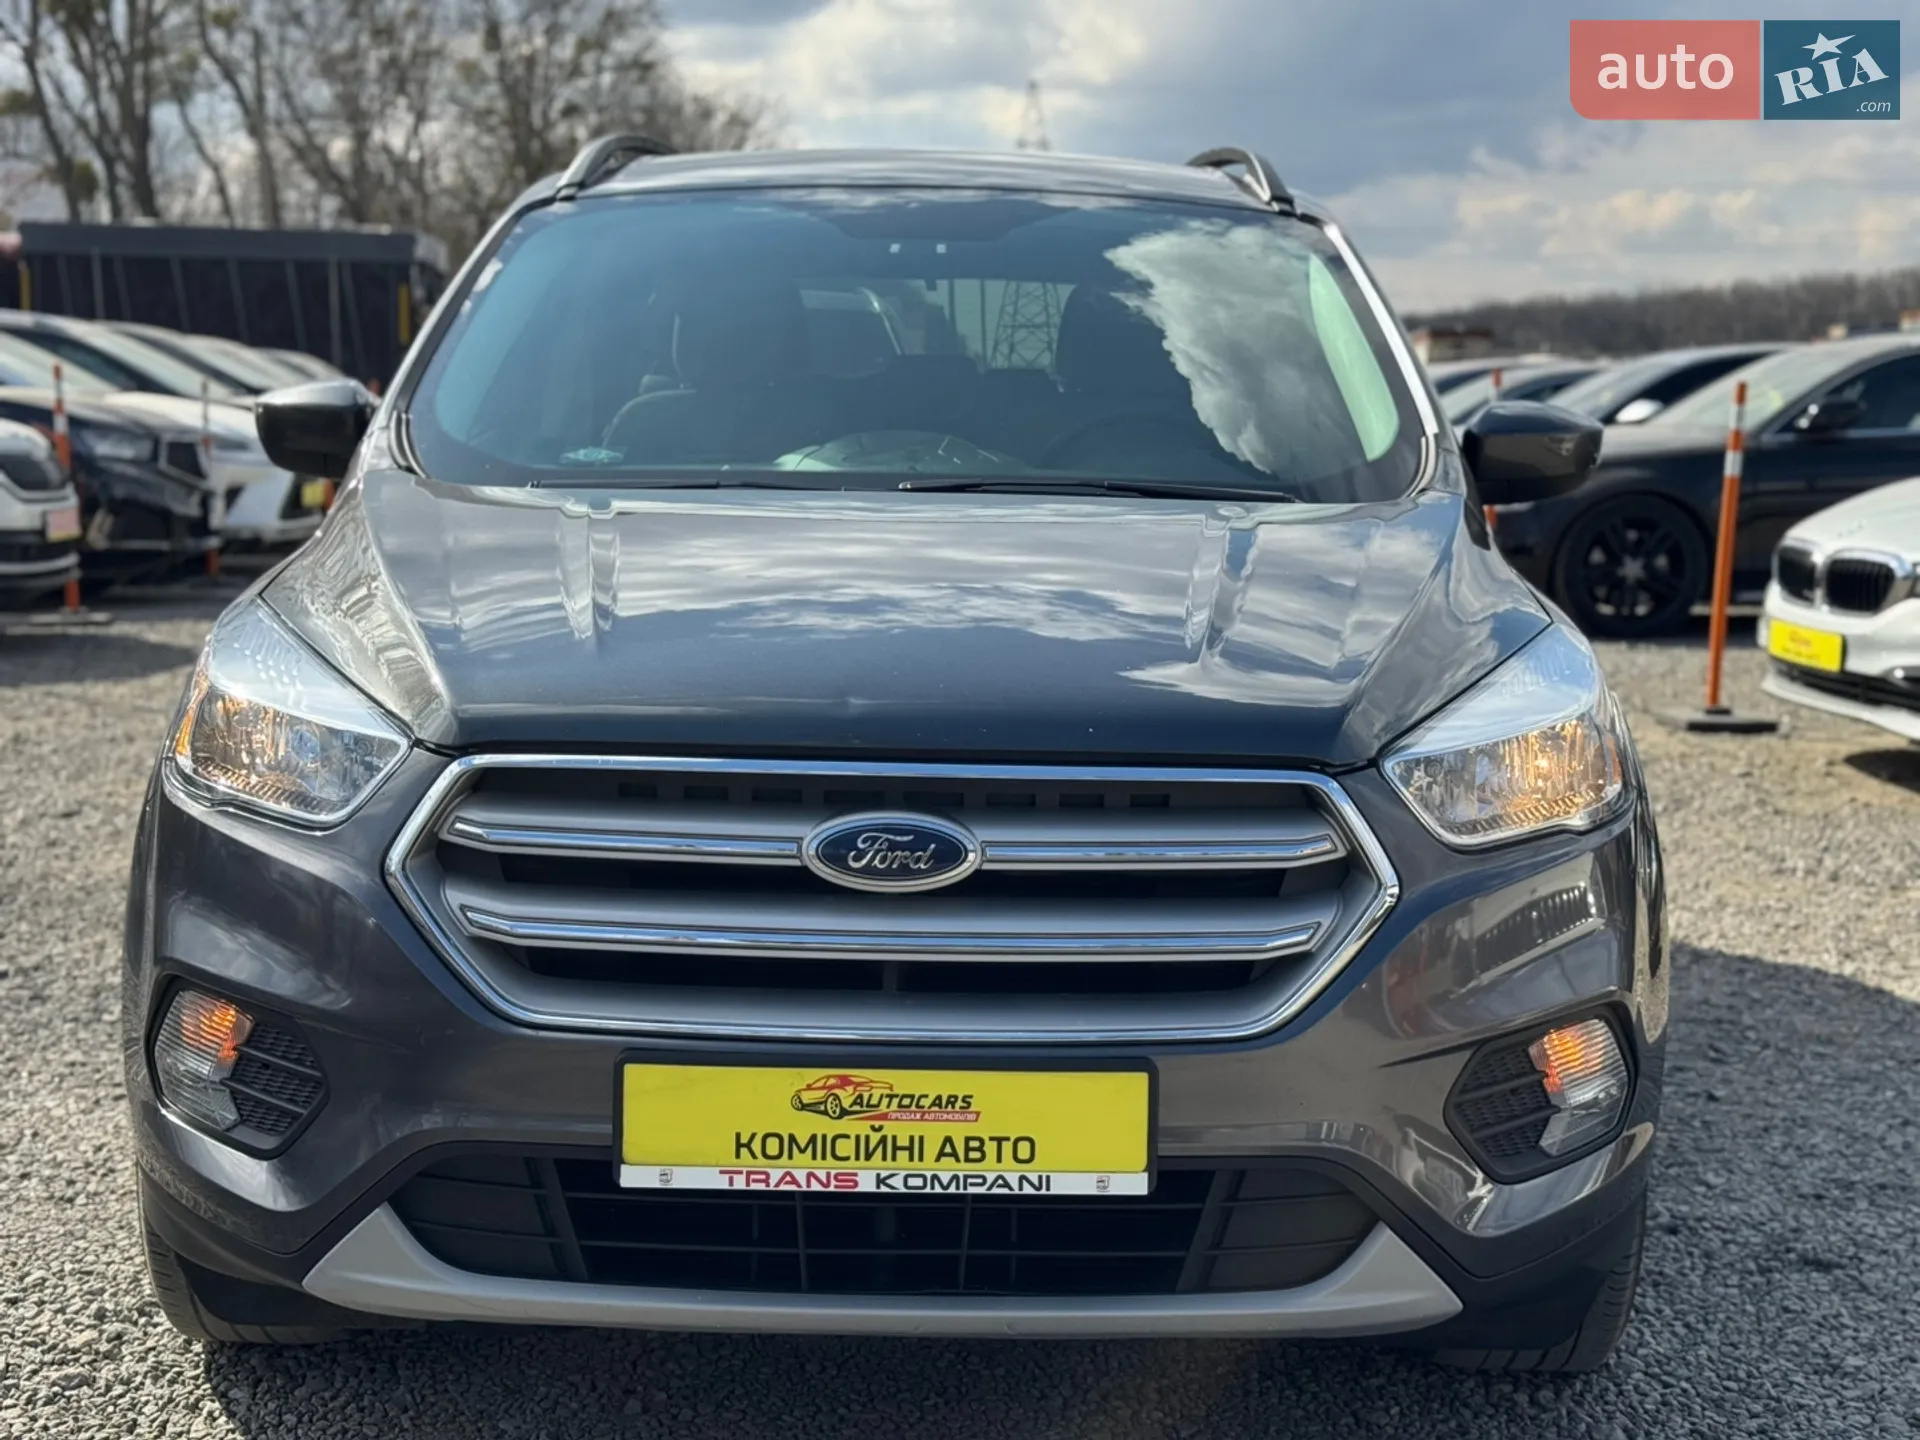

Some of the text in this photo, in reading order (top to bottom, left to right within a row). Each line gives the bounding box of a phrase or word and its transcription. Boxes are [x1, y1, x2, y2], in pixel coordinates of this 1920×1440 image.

[847, 832, 936, 869] Ford
[848, 1093, 974, 1110] AUTOCARS
[887, 1112, 921, 1120] ПРОДАЖ
[734, 1124, 1036, 1164] КОМІСІЙНІ АВТО
[719, 1169, 1051, 1193] TRANS KOMPANI
